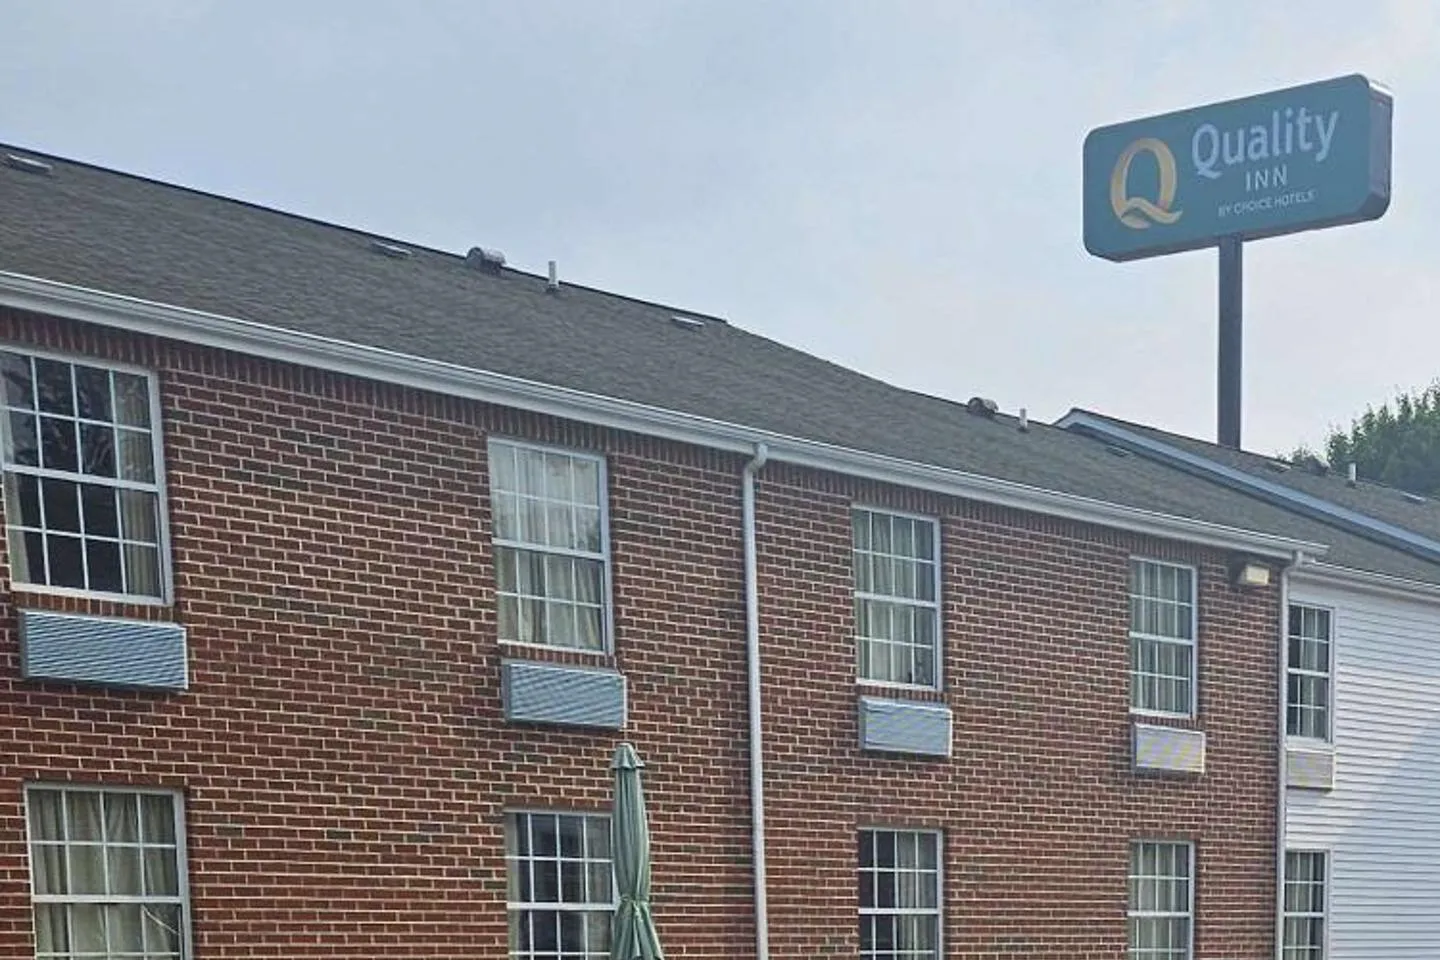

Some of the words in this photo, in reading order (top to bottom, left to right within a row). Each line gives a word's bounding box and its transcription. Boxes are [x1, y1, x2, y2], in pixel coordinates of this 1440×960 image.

[1191, 106, 1339, 179] Quality
[1110, 138, 1183, 229] Q
[1245, 164, 1288, 192] INN
[1233, 198, 1272, 215] CHOICE
